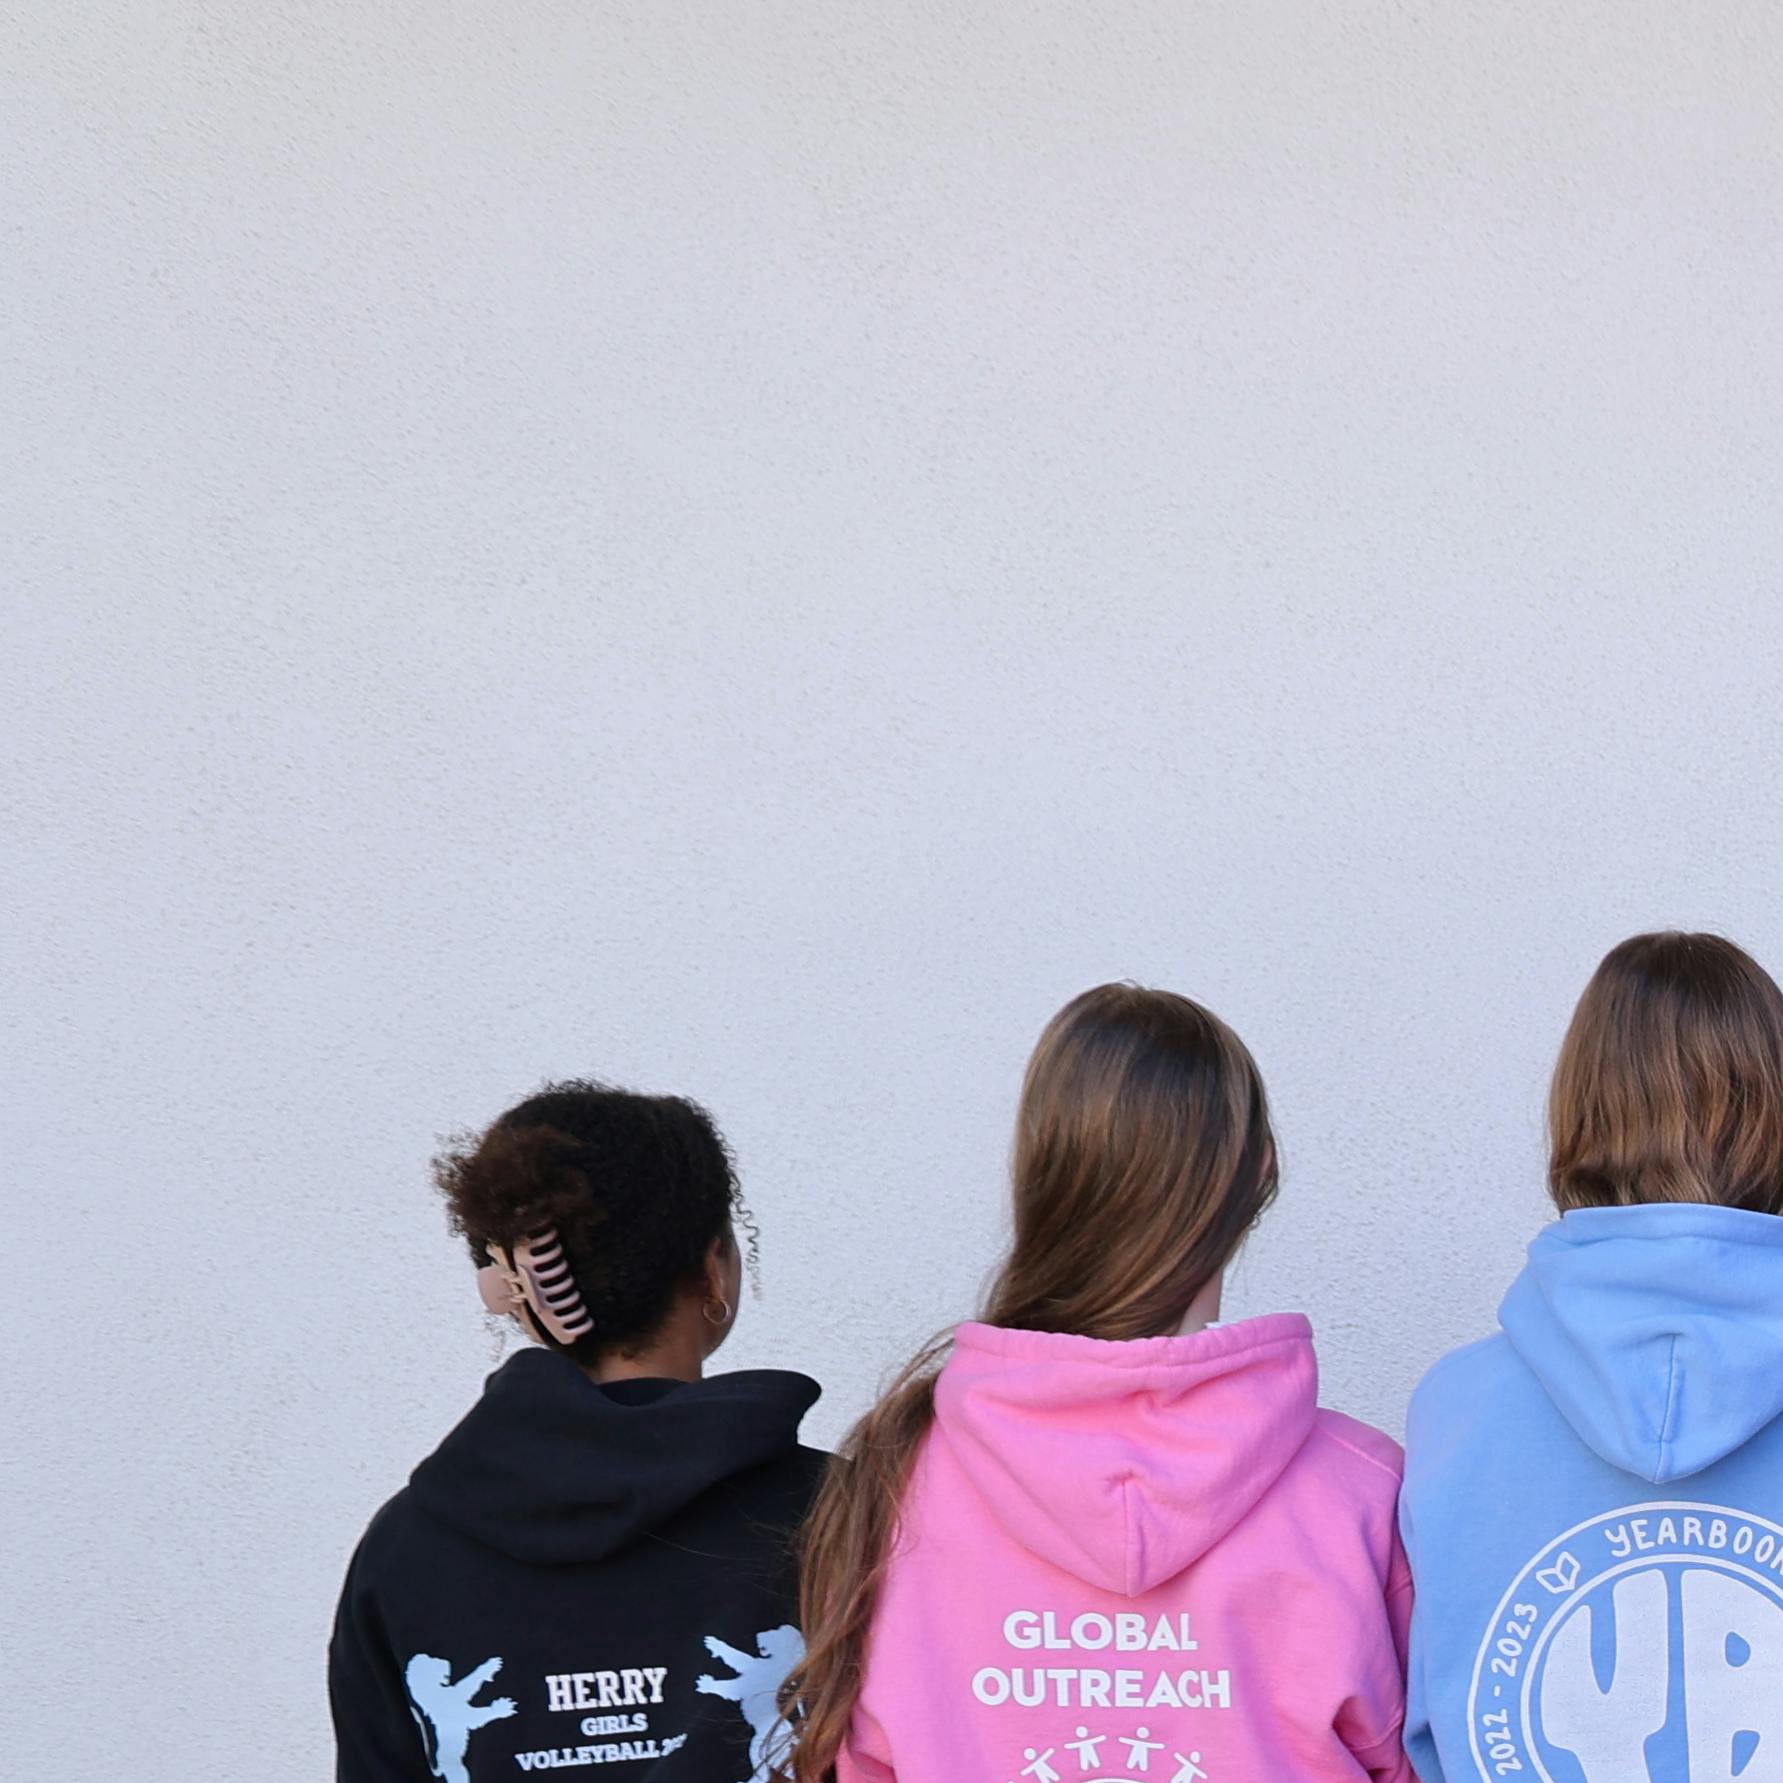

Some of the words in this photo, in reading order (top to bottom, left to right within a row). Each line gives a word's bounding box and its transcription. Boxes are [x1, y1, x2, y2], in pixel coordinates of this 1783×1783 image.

[1002, 1609, 1199, 1651] GLOBAL
[1490, 1603, 1538, 1677] 2023
[545, 1667, 668, 1712] HERRY
[971, 1666, 1232, 1709] OUTREACH
[580, 1712, 649, 1736] GIRLS
[1482, 1708, 1523, 1776] 2022
[515, 1739, 660, 1771] VOLLEYBALL
